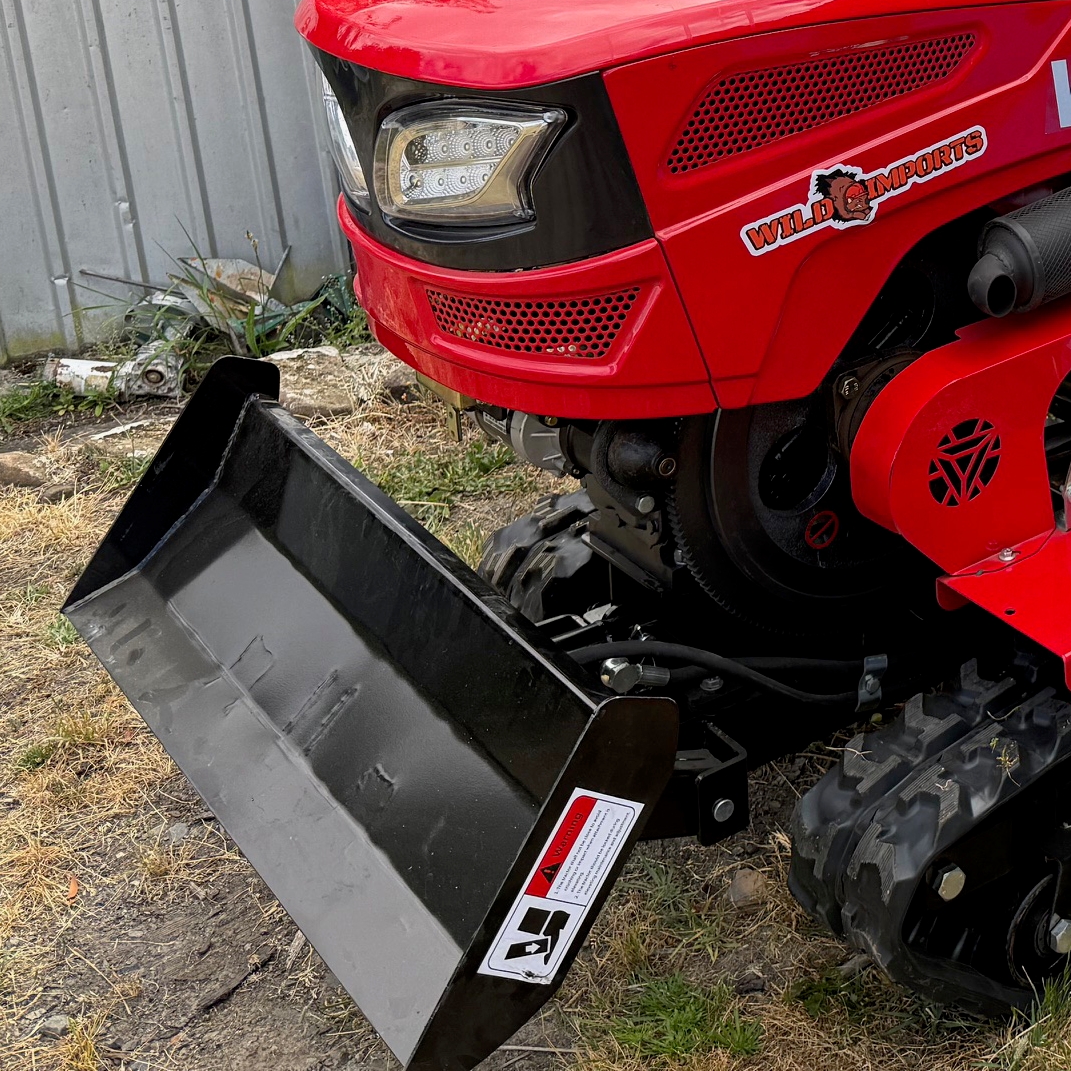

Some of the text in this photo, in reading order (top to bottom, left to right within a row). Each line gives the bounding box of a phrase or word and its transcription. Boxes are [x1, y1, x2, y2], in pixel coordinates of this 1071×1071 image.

[746, 130, 984, 251] WILD IMPORTS
[552, 811, 584, 858] Warning
